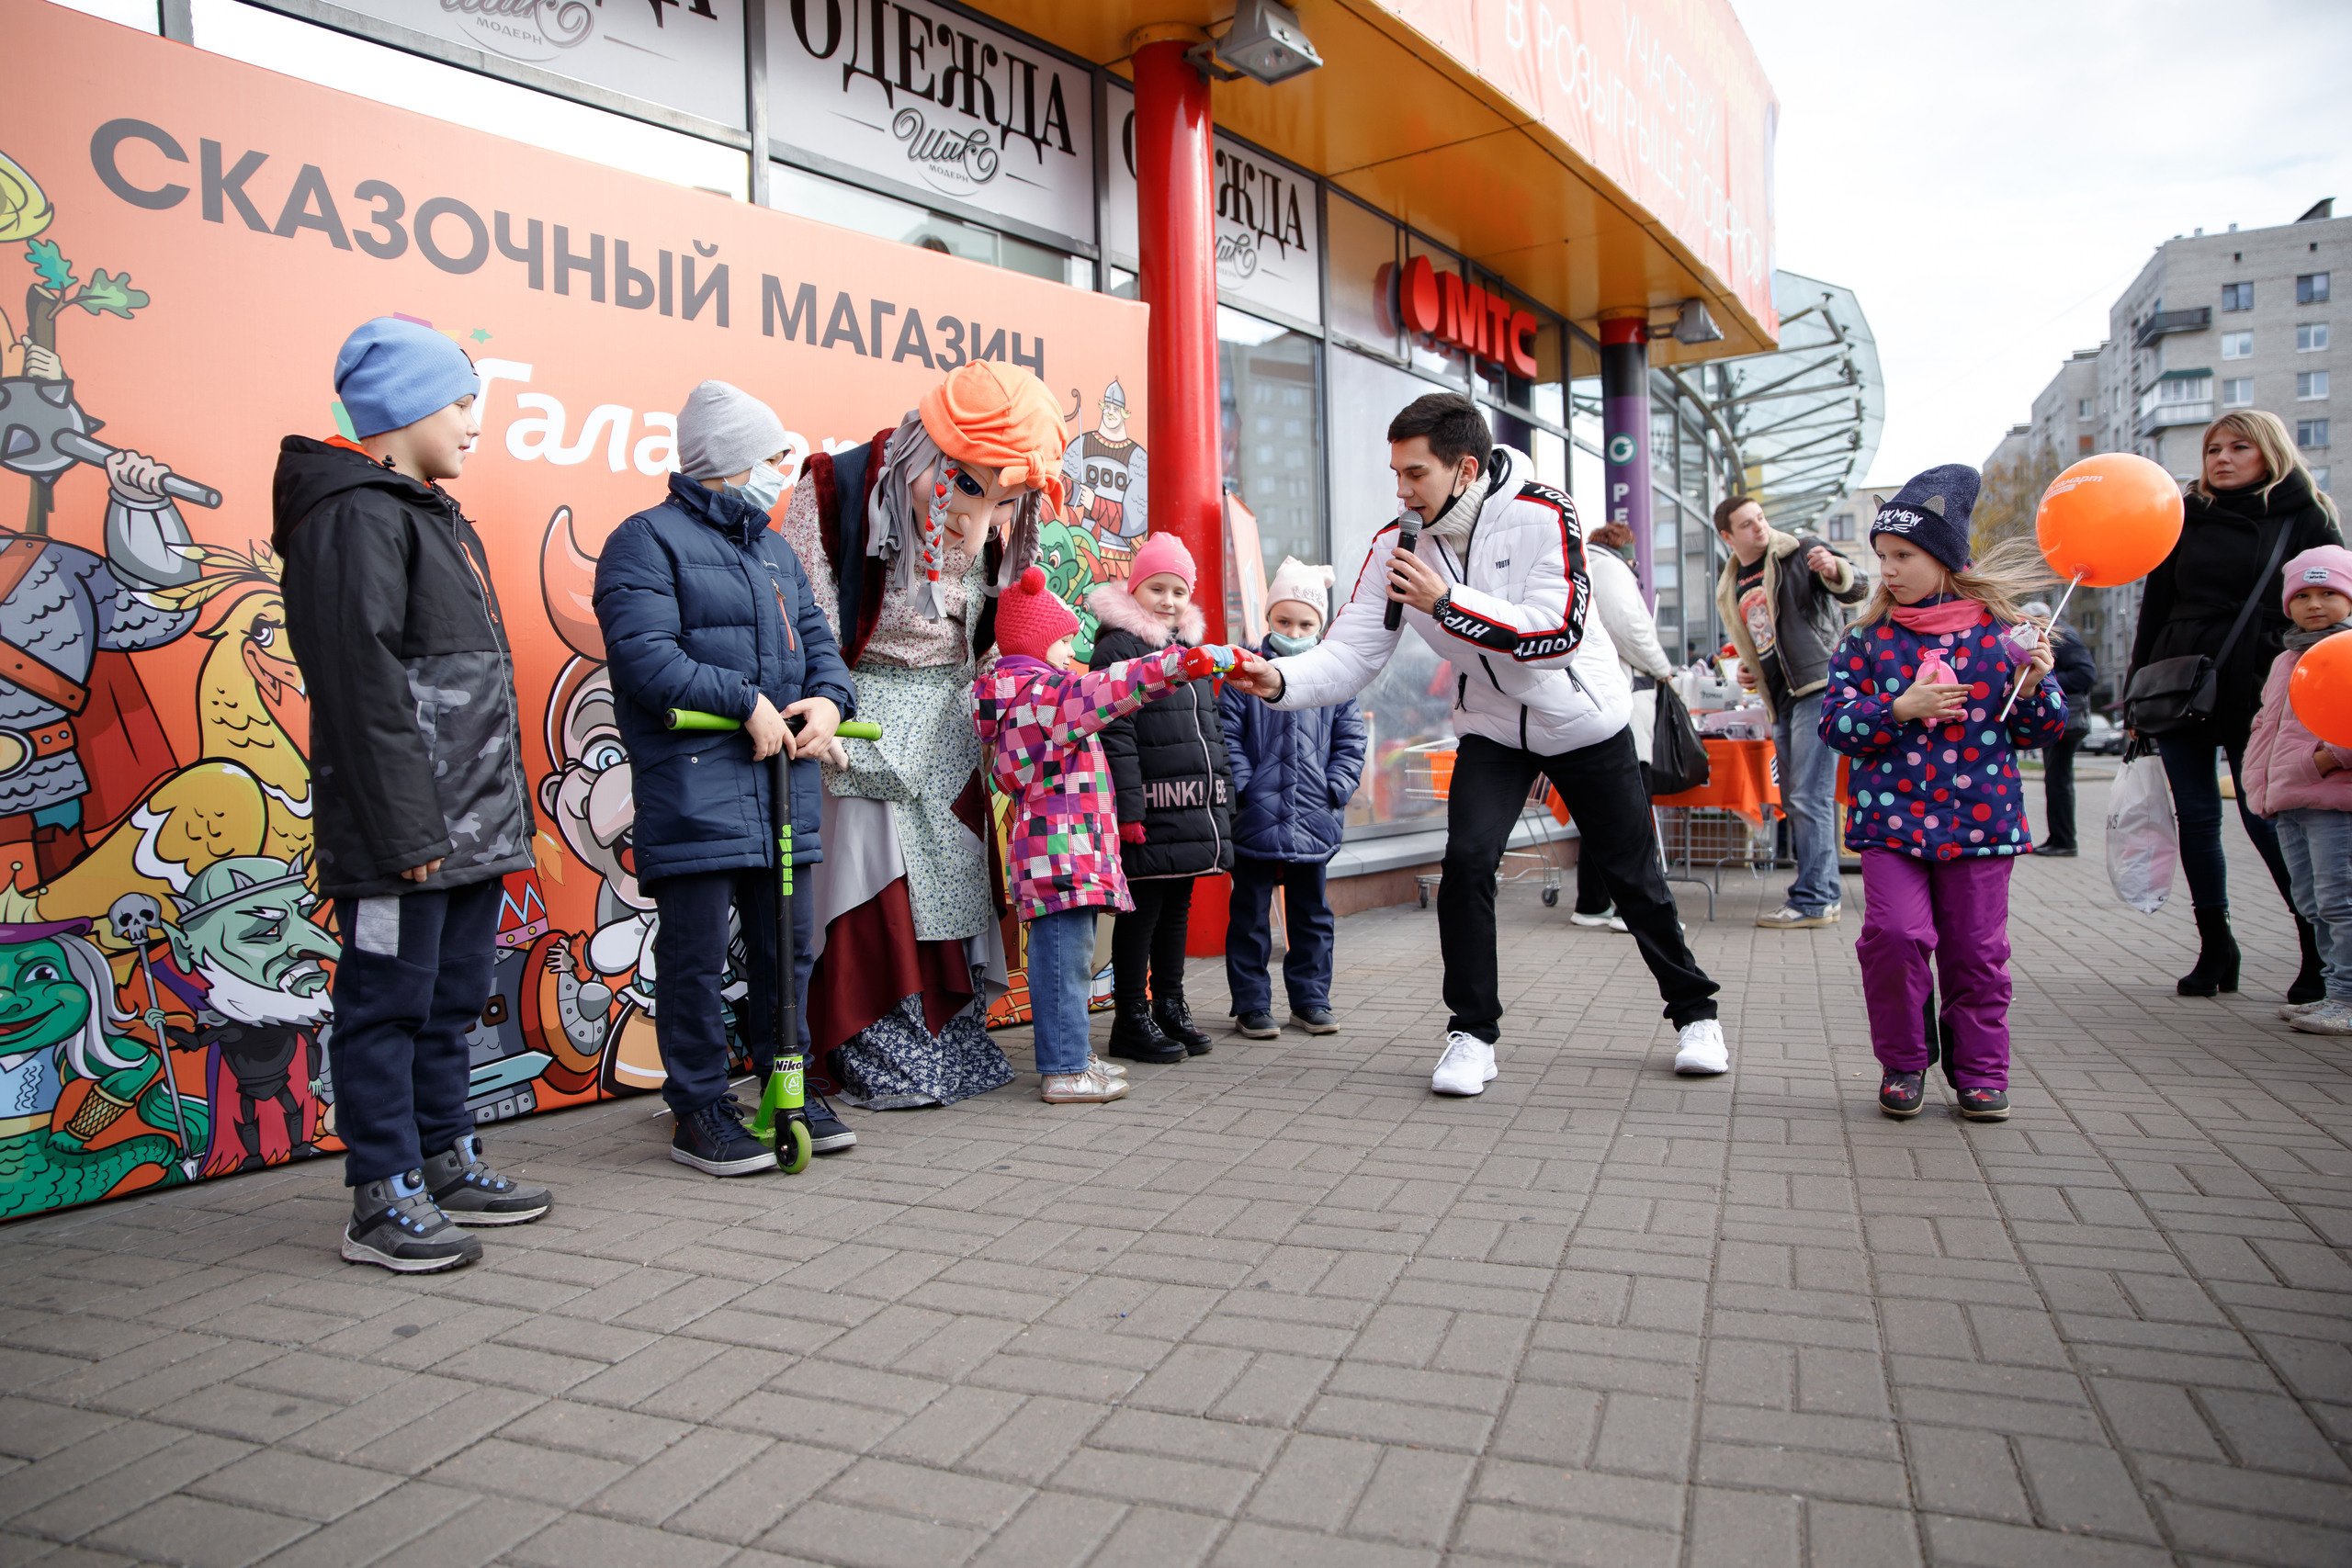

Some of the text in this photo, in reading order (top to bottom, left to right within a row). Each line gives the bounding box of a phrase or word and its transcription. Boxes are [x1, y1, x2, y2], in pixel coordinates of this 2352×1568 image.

[476, 16, 543, 45] МОДЕРН
[790, 0, 1077, 164] ОДЕЖДА
[928, 164, 969, 184] МОДЕРН
[90, 118, 1045, 382] СКАЗОЧНЫЙ МАГАЗИН
[1436, 270, 1538, 379] МТС
[464, 357, 861, 491] Галаа
[1533, 485, 1582, 540] YOUTH
[1892, 508, 1924, 527] MEW
[1572, 571, 1590, 630] HYPE
[1443, 610, 1491, 638] HYP
[1141, 780, 1204, 808] HINK!
[775, 1059, 803, 1072] Niko
